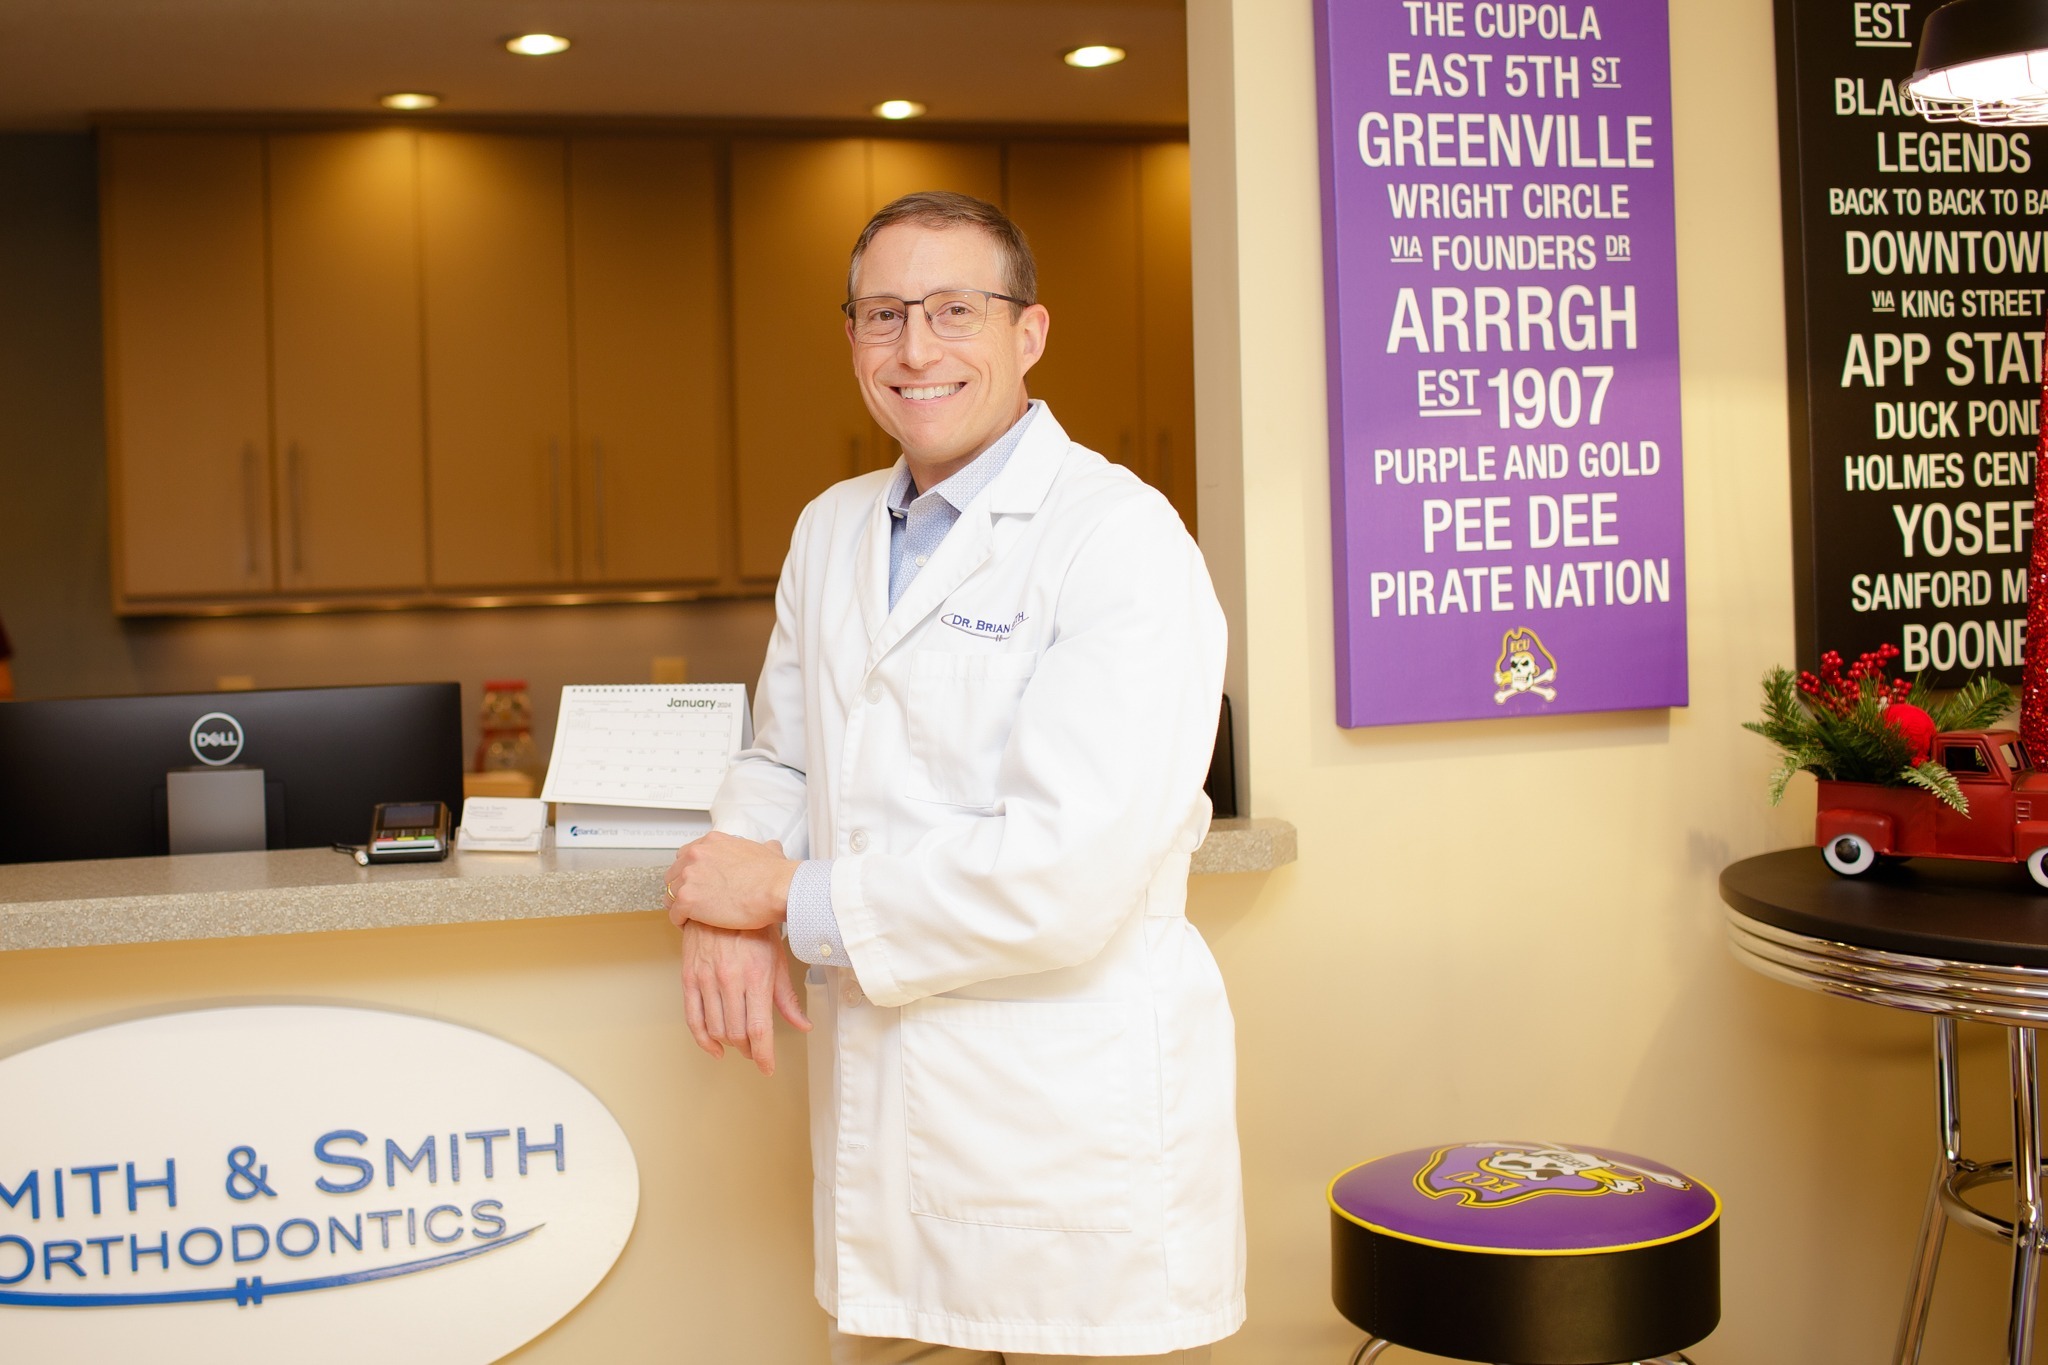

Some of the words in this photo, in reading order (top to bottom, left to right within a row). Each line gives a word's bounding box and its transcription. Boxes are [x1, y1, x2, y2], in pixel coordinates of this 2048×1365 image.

[1403, 1, 1465, 37] THE
[1474, 3, 1602, 40] CUPOLA
[1855, 3, 1910, 38] EST
[1388, 53, 1493, 97] EAST
[1506, 55, 1579, 98] 5TH
[1592, 57, 1620, 82] ST
[1835, 78, 1942, 116] BLA
[1358, 112, 1654, 168] GREENVILLE
[1878, 132, 2030, 173] LEGENDS
[1387, 183, 1513, 219] WRIGHT
[1523, 184, 1629, 219] CIRCLE
[1830, 188, 1888, 215] BACK
[1893, 189, 1921, 215] TO
[1929, 189, 1985, 215] BACK
[1991, 189, 2017, 215] TO
[1390, 236, 1423, 257] VIA
[1432, 235, 1596, 271] FOUNDERS
[1605, 235, 1630, 256] DR
[1846, 230, 2048, 275] DOWNTOW
[1386, 285, 1637, 354] ARRRGH
[1872, 291, 1894, 307] VIA
[1902, 290, 1954, 317] KING
[1962, 290, 2045, 317] STREET
[1841, 333, 1930, 387] APP
[1418, 369, 1480, 407] EST
[1487, 366, 1614, 429] 1907
[1876, 401, 1961, 440] DUCK
[1374, 446, 1497, 485] PURPLE
[1503, 443, 1569, 481] AND
[1578, 441, 1660, 478] GOLD
[1846, 453, 1965, 492] HOLMES
[1423, 496, 1512, 553] PEE
[1529, 492, 1619, 549] DEE
[1893, 501, 2035, 558] YOSEF
[1370, 566, 1514, 617] PIRATE
[1525, 558, 1669, 609] NATION
[1852, 570, 1992, 612] SANFORD
[952, 614, 972, 628] DR.
[1903, 618, 2028, 673] BOONE
[667, 697, 717, 710] January
[197, 731, 238, 747] DELL
[225, 1145, 278, 1200] &
[314, 1123, 567, 1194] SMITH
[0, 1200, 509, 1284] ORTHODONTICS
